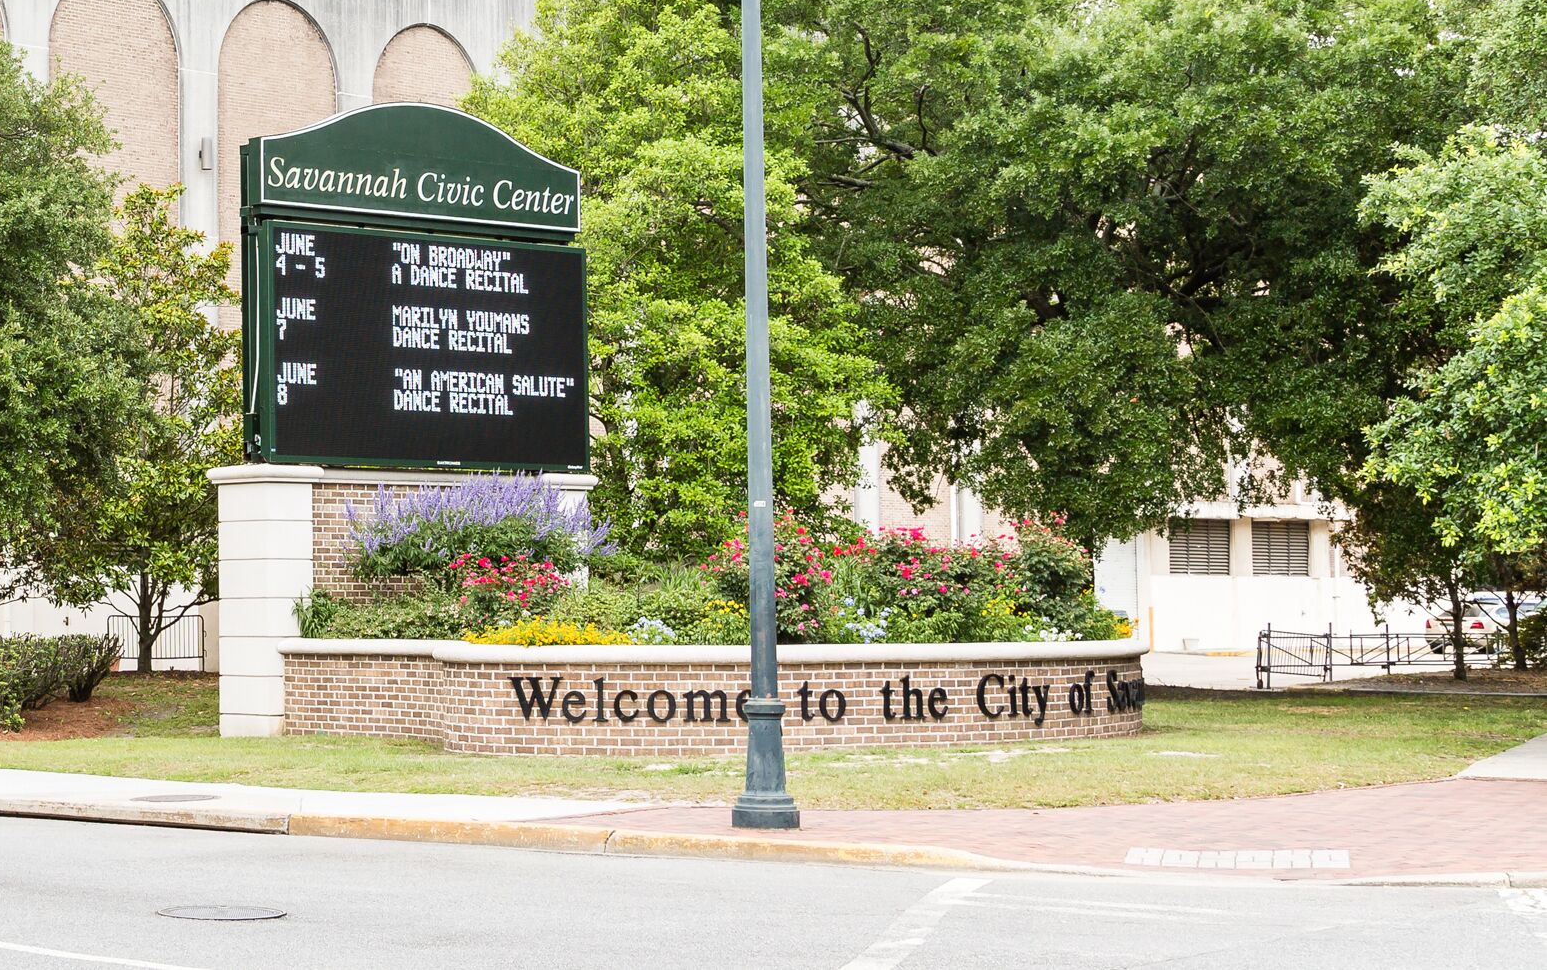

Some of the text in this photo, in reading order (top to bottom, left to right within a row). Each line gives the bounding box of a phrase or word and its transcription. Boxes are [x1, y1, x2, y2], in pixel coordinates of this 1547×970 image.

[267, 156, 575, 215] Savannah Civic Center
[275, 232, 316, 256] JUNE
[392, 242, 511, 272] "ON BROADWAY"
[275, 254, 286, 276] 4
[315, 256, 326, 278] 5
[391, 263, 529, 294] A DANCE RECITAL
[276, 297, 316, 320] JUNE
[392, 305, 530, 335] MARILYN YOUMANS
[276, 318, 287, 340] 7
[392, 326, 513, 354] DANCE RECITAL
[277, 362, 317, 385] JUNE
[394, 368, 575, 398] "AN AMERICAN SALUTE"
[277, 383, 288, 405] 8
[393, 389, 514, 415] DANCE RECITAL
[796, 680, 847, 723] to
[879, 674, 949, 720] the
[976, 673, 1050, 727] City
[1068, 670, 1095, 715] of
